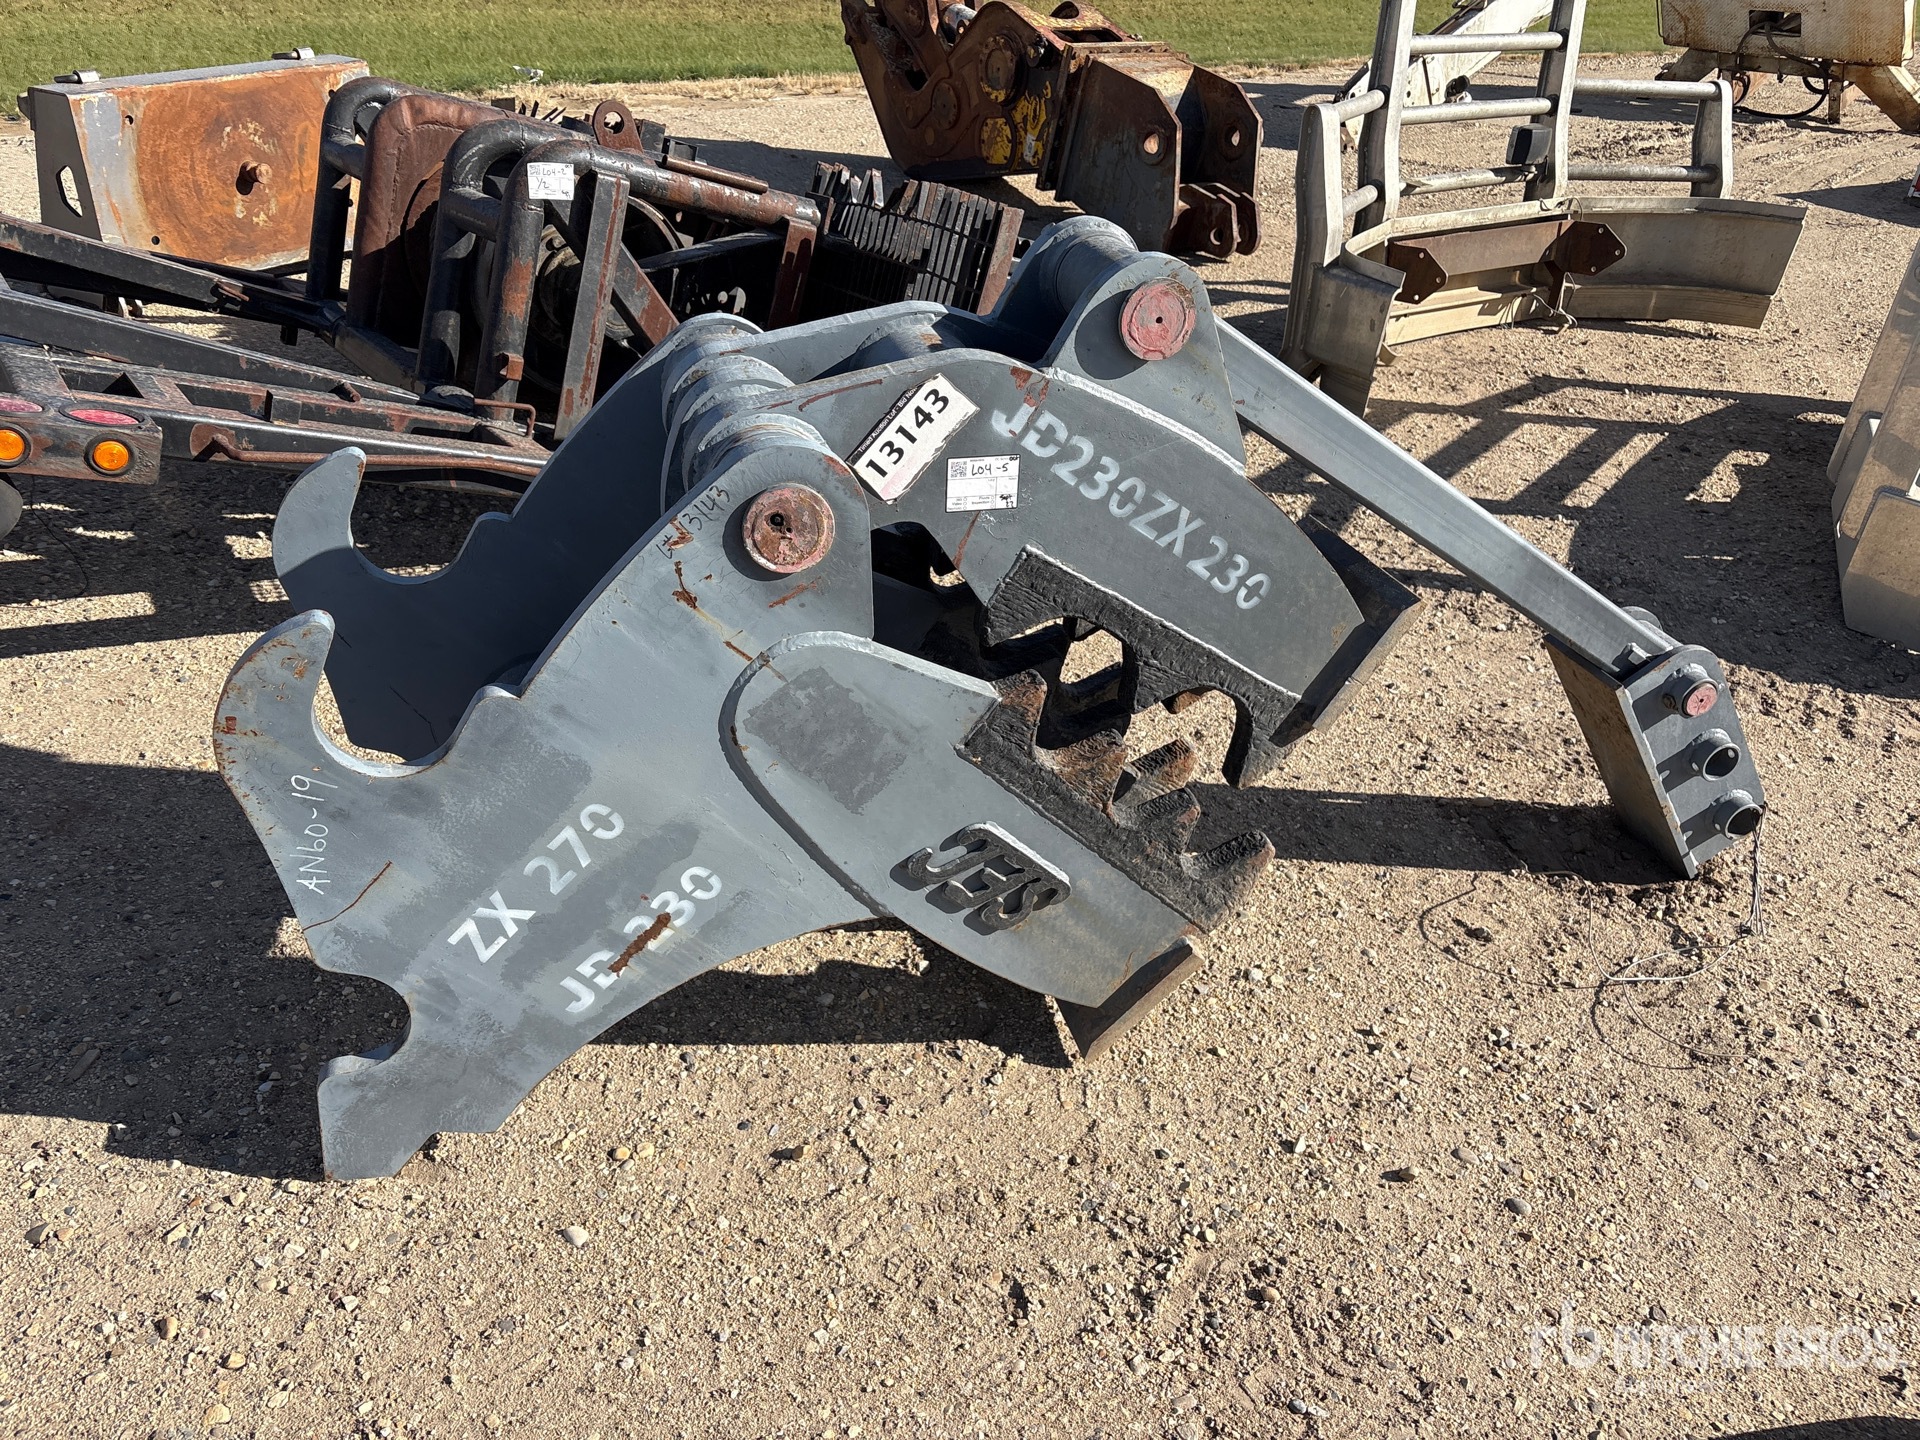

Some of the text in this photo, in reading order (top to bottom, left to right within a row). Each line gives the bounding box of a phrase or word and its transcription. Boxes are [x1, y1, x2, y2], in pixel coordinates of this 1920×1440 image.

[859, 435, 874, 452] Timed
[871, 418, 890, 438] Auction
[887, 408, 897, 420] Lot
[898, 397, 908, 408] Bid
[865, 388, 949, 478] 13143
[679, 485, 730, 535] 13143
[1186, 535, 1272, 610] 230
[447, 803, 625, 964] ZX 270
[623, 866, 723, 951] 230
